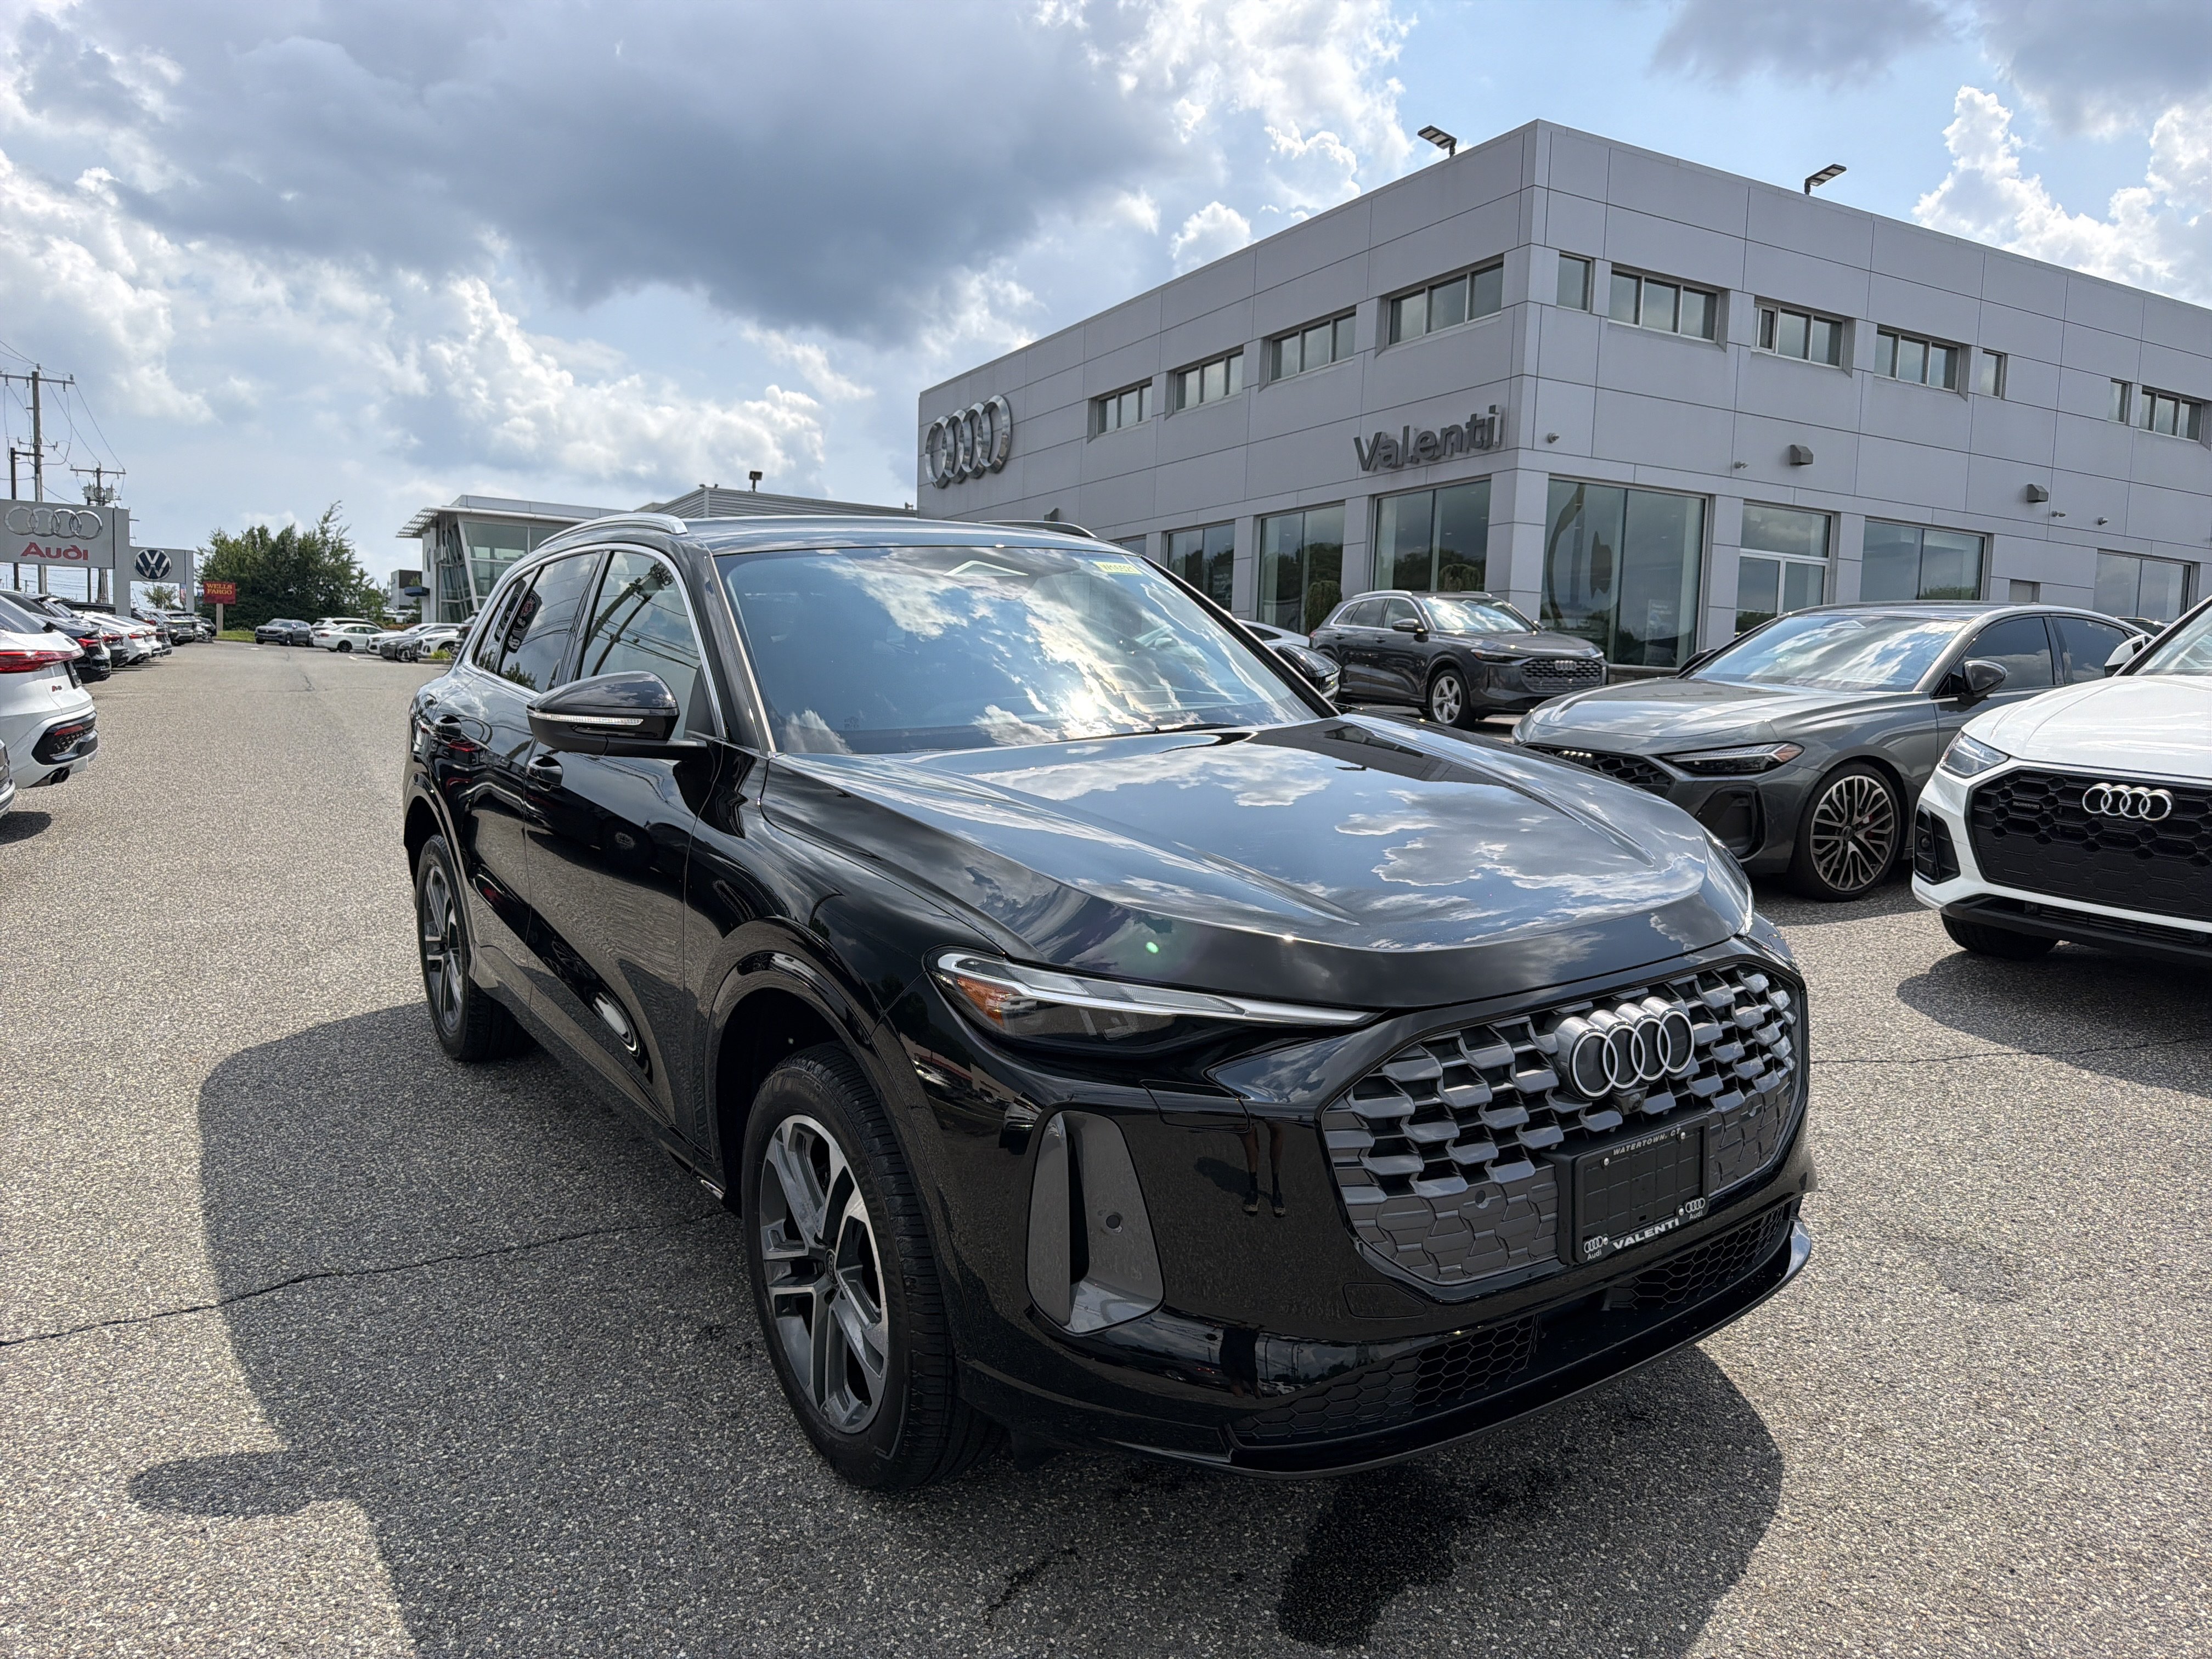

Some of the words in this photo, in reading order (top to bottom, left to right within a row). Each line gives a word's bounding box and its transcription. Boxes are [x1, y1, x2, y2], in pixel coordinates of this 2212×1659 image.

[1353, 405, 1502, 471] Valenti
[20, 541, 88, 561] Audi
[1670, 1127, 1681, 1136] CT
[1689, 1210, 1703, 1220] Audi
[1613, 1217, 1679, 1249] VALENTI
[1587, 1248, 1602, 1261] Audi
